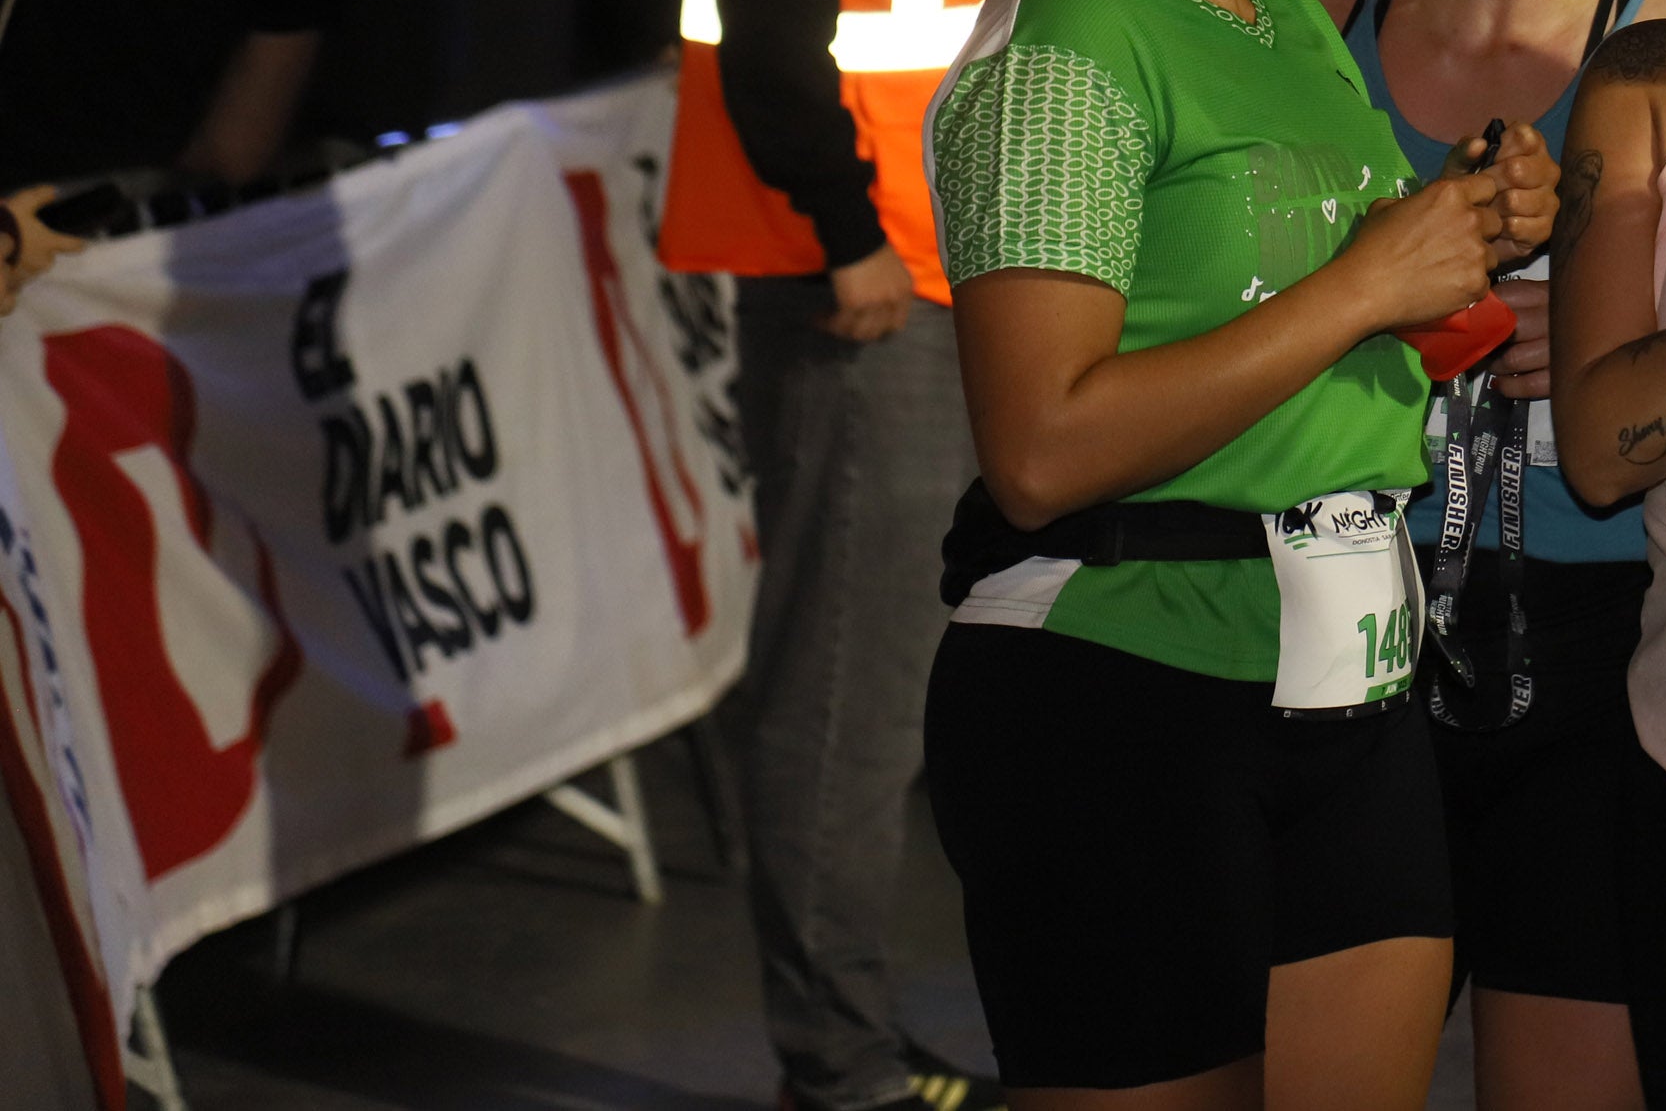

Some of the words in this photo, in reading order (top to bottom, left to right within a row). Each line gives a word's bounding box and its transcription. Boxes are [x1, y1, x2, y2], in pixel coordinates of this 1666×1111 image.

[293, 271, 354, 401] EL
[322, 359, 497, 546] DIARIO
[1441, 443, 1469, 551] FINISHER
[1474, 432, 1491, 475] NIGHTRUN
[1501, 446, 1523, 551] FINISHER
[345, 505, 535, 682] VASCO
[1435, 594, 1448, 636] NIGHTRUN
